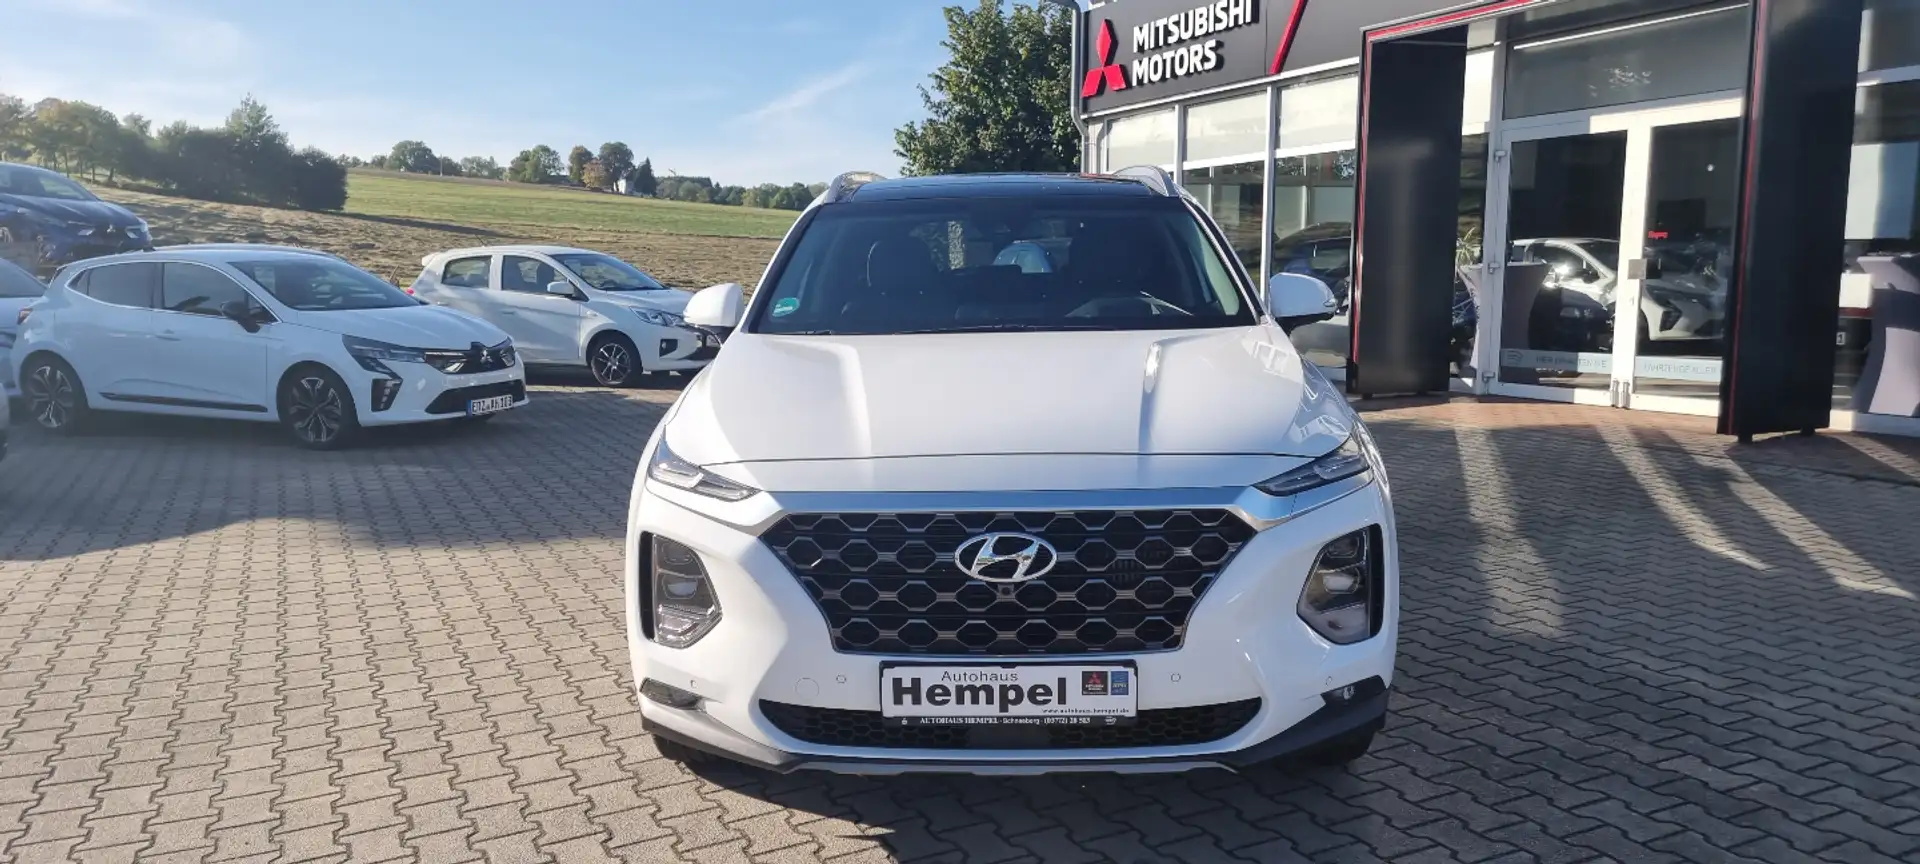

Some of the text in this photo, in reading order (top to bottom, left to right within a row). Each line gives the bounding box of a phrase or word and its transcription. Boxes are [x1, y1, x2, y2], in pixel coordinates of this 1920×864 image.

[1133, 0, 1252, 52] MITSUBISHI
[1132, 39, 1217, 87] MOTORS
[892, 677, 1067, 713] Hempel
[941, 670, 1019, 682] Autohaus
